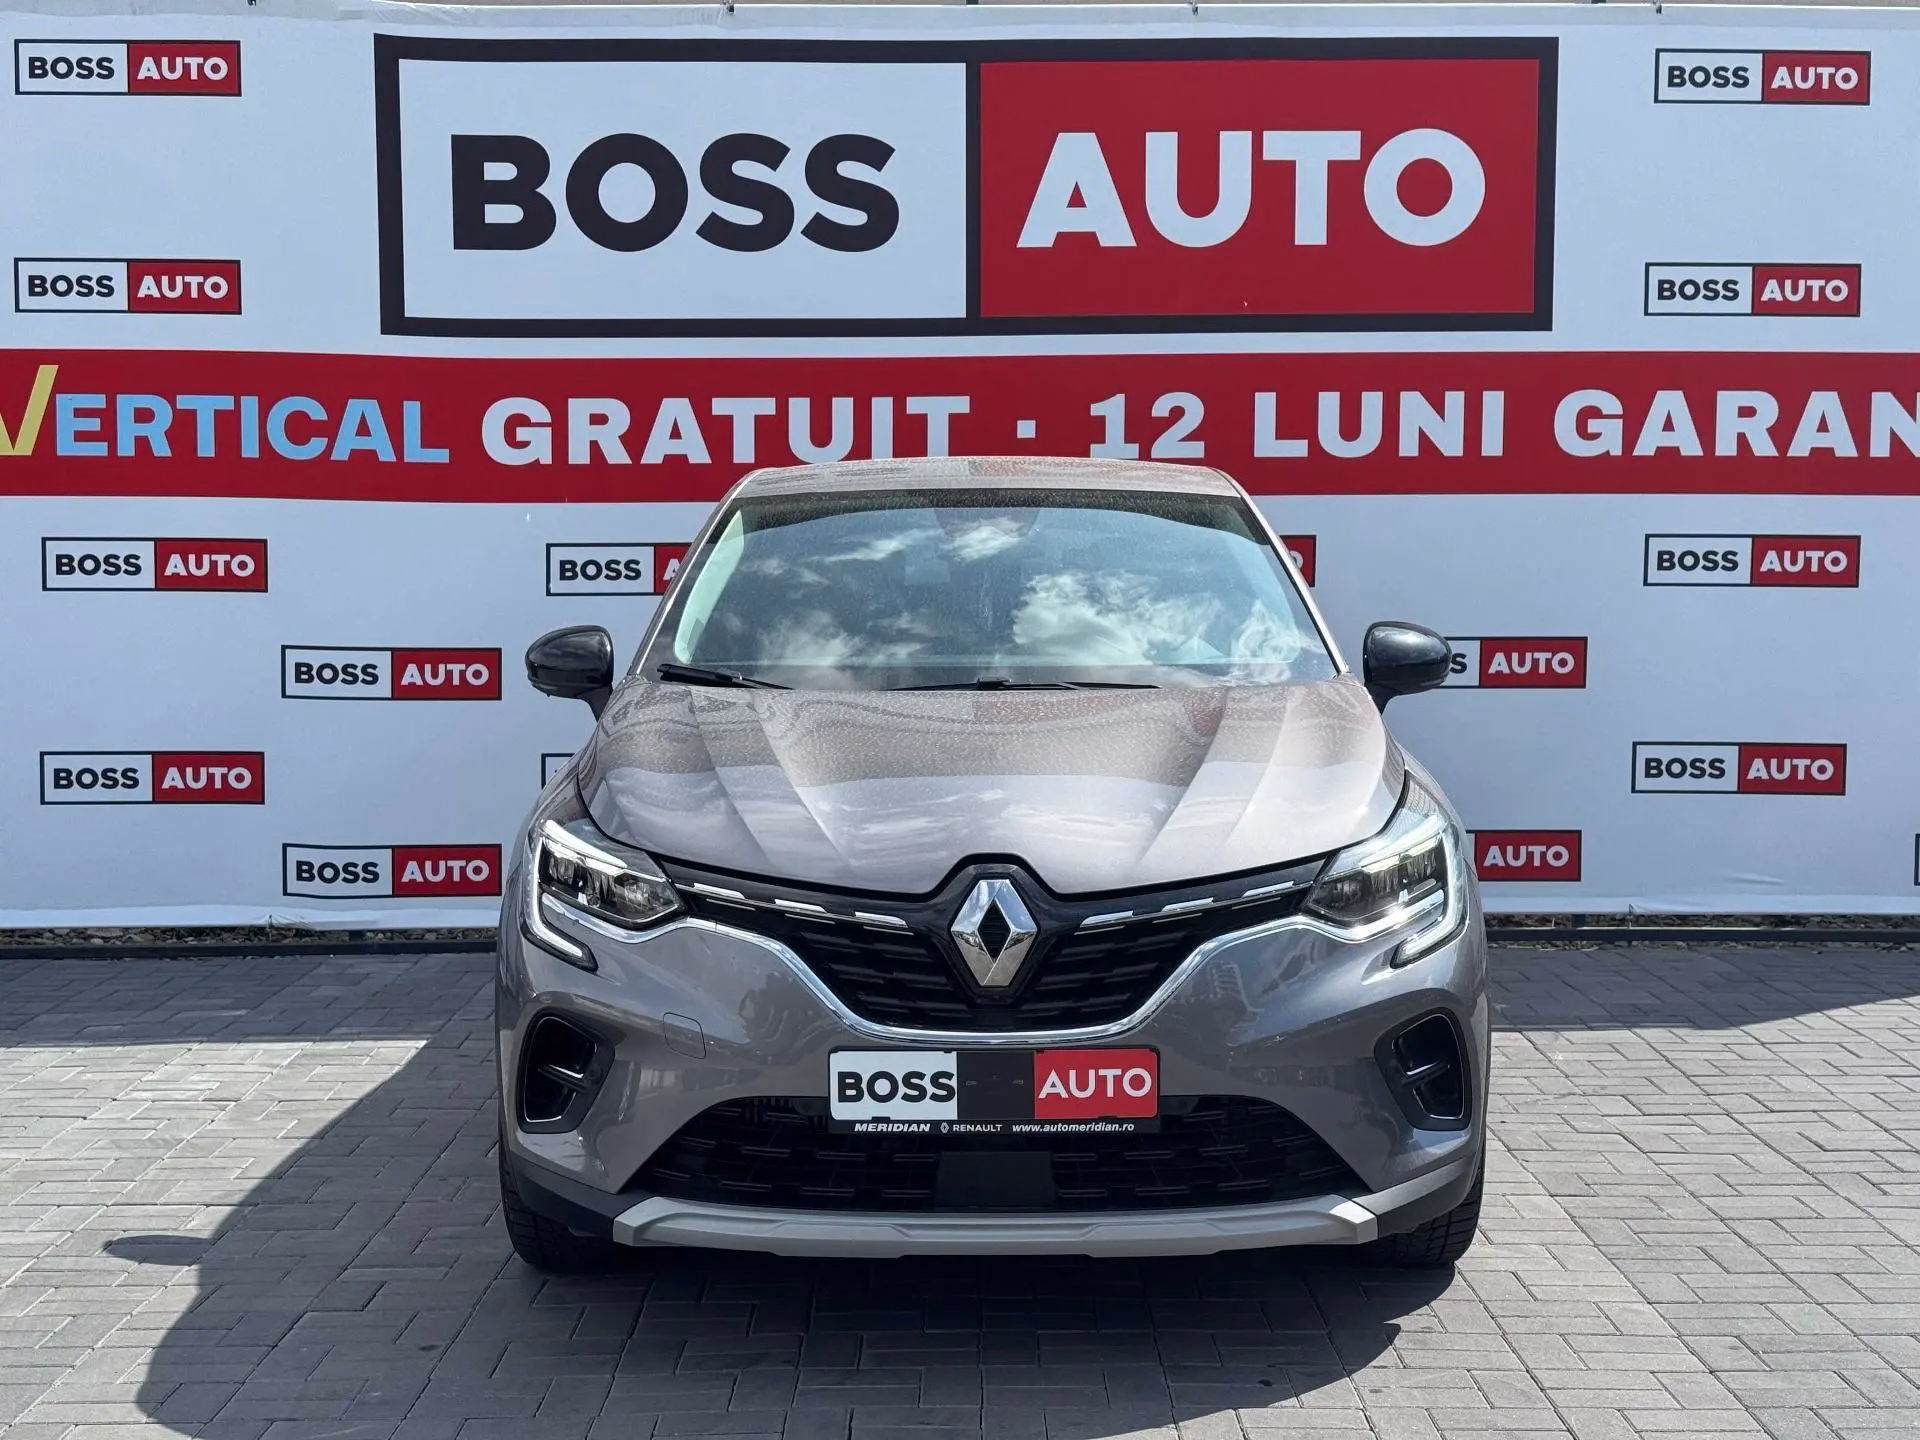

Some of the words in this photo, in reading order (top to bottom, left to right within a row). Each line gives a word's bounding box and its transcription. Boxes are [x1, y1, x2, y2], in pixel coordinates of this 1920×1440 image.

[29, 57, 114, 79] BOSS
[138, 57, 228, 80] AUTO
[1668, 66, 1749, 88] BOSS
[1771, 67, 1858, 89] AUTO
[451, 133, 899, 252] BOSS
[1017, 128, 1485, 247] AUTO
[28, 275, 114, 297] BOSS
[138, 276, 228, 298] AUTO
[1658, 279, 1739, 301] BOSS
[1761, 280, 1848, 302] AUTO
[0, 365, 449, 463] VERTICAL
[482, 396, 970, 465] GRATUIT
[1089, 392, 1204, 458] 12
[1254, 391, 1504, 458] LUNI
[1554, 390, 1920, 457] GARAN
[56, 554, 141, 576] BOSS
[164, 554, 254, 576] AUTO
[560, 559, 641, 581] BOSS
[1657, 550, 1738, 571] BOSS
[1760, 551, 1847, 572] AUTO
[295, 662, 379, 685] BOSS
[401, 664, 489, 685] AUTO
[1488, 652, 1574, 673] AUTO
[54, 768, 139, 789] BOSS
[162, 767, 251, 789] AUTO
[1645, 758, 1725, 779] BOSS
[1747, 759, 1833, 780] AUTO
[1484, 846, 1569, 866] AUTO
[296, 860, 379, 884] BOSS
[402, 860, 489, 882] AUTO
[838, 1071, 955, 1103] BOSS
[1039, 1068, 1151, 1098] AUTO
[854, 1123, 930, 1132] MERIDIAN
[1012, 1123, 1135, 1133] www.automeridian.ro
